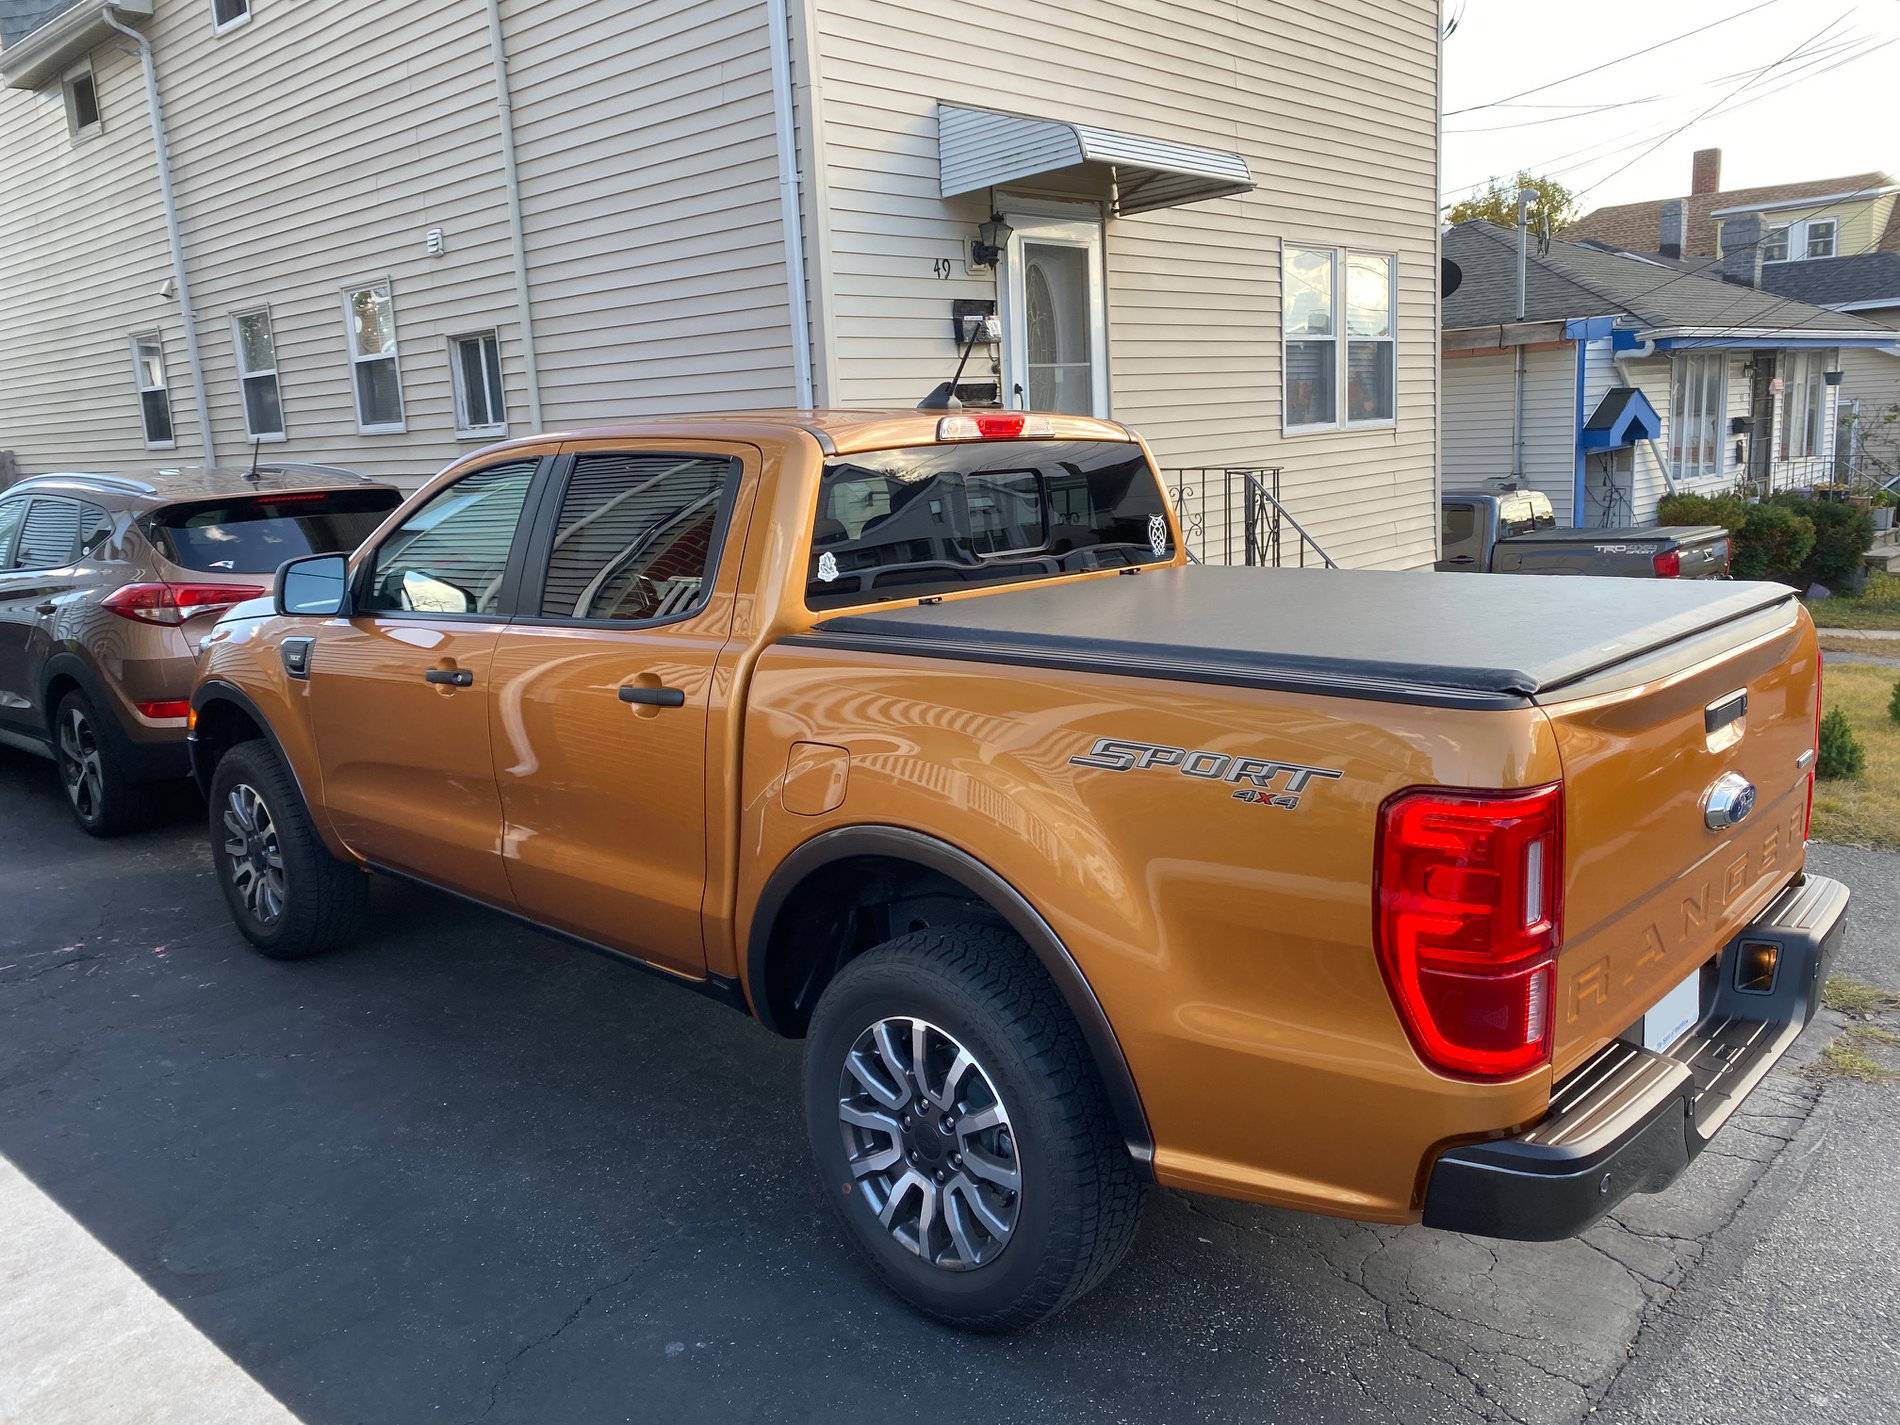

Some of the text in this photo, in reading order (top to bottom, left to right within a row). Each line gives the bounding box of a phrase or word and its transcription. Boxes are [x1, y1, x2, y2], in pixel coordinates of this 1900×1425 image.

[933, 258, 951, 280] 49
[1069, 738, 1344, 793] SPORT
[1567, 801, 1804, 1024] RANGER
